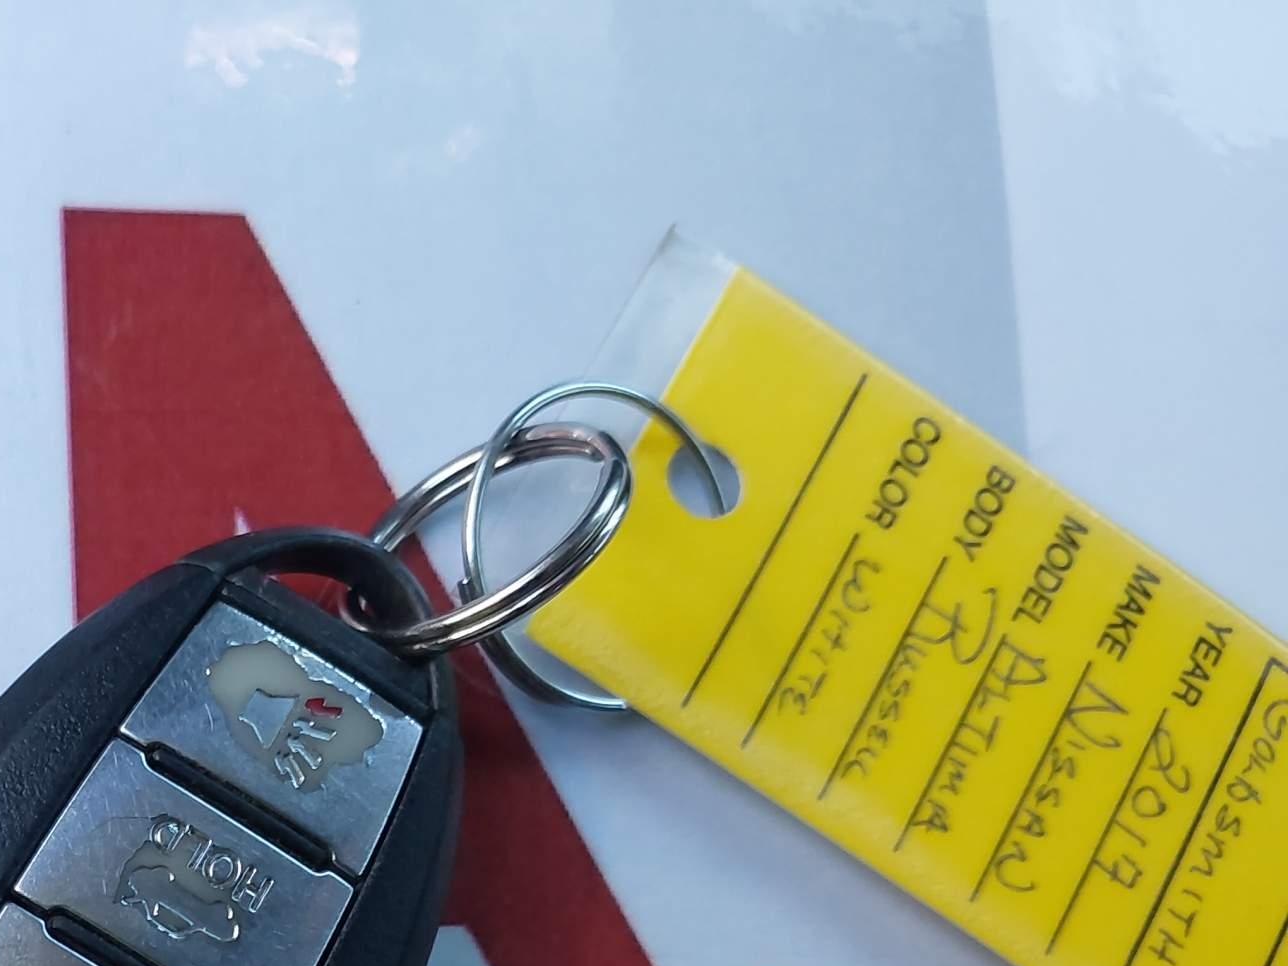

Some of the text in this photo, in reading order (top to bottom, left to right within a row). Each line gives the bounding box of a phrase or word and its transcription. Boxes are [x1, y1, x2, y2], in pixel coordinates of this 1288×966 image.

[865, 416, 941, 530] COLOR
[954, 466, 1016, 563] BODY
[1012, 515, 1089, 625] MODEL
[1096, 564, 1161, 662] MAKE
[1171, 621, 1233, 708] YEAR
[149, 820, 275, 914] HOLD
